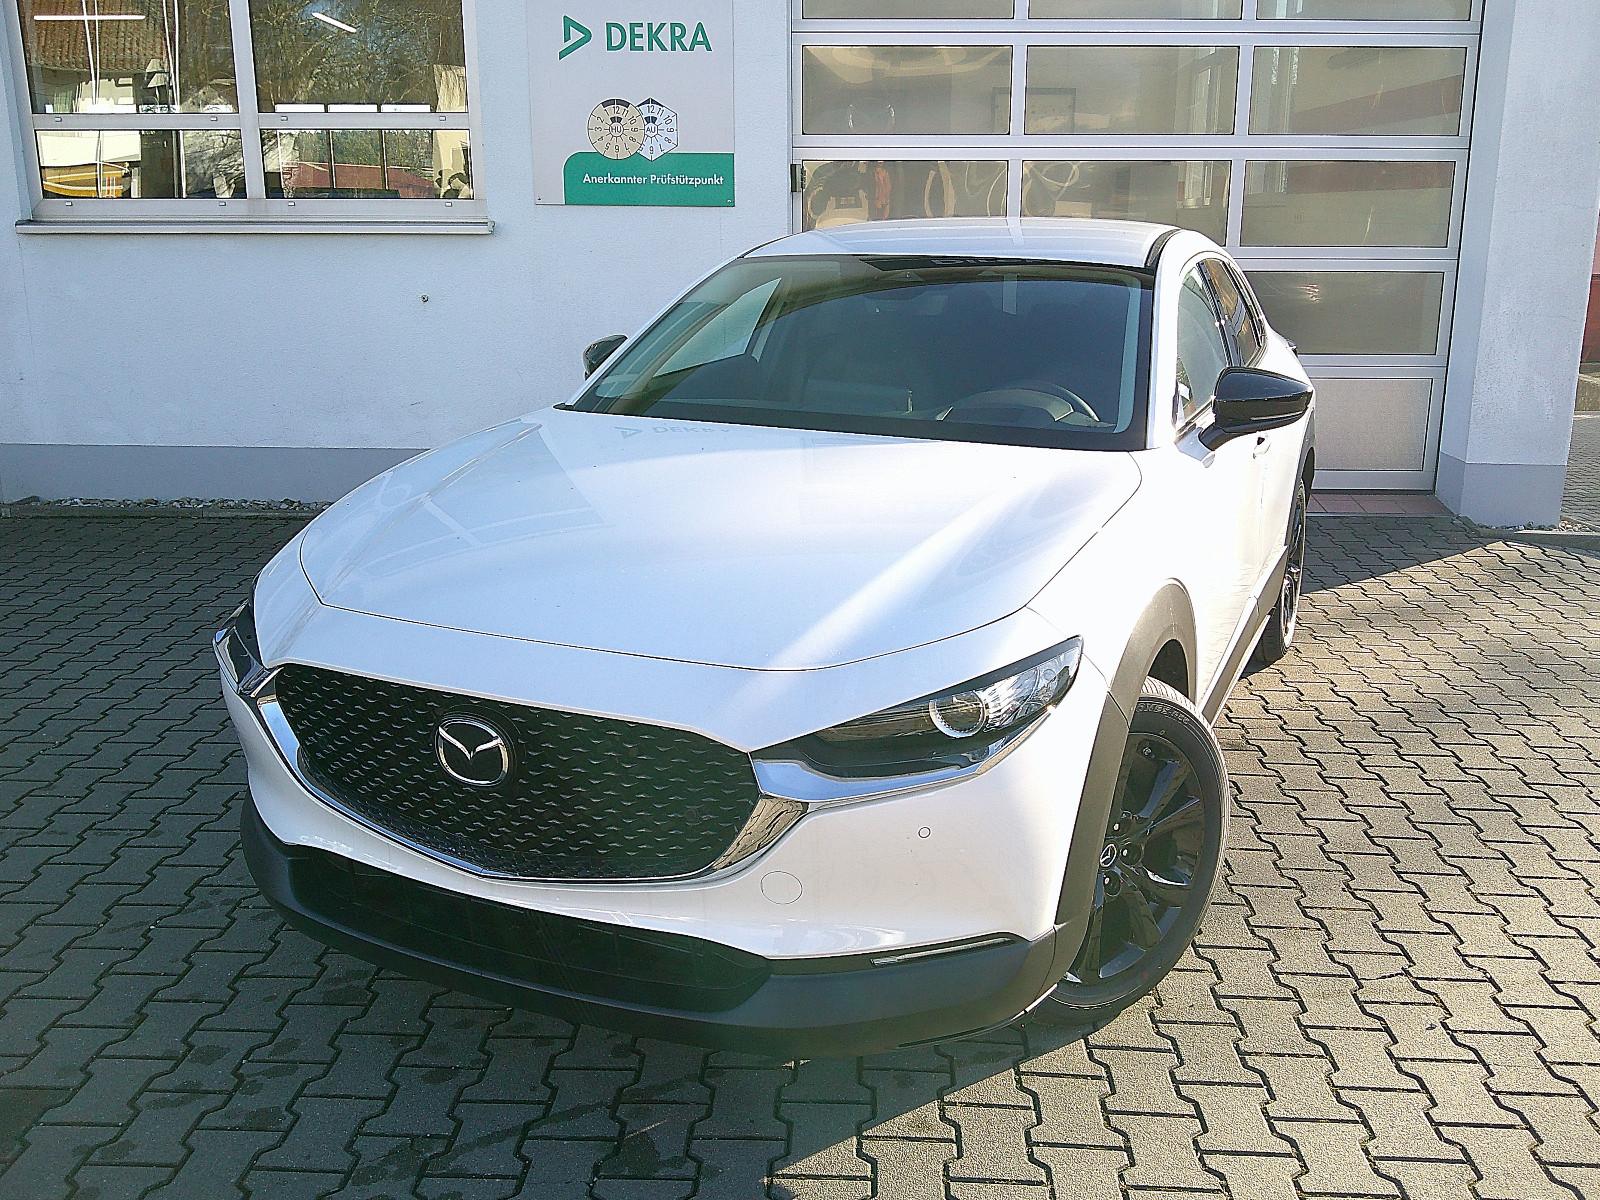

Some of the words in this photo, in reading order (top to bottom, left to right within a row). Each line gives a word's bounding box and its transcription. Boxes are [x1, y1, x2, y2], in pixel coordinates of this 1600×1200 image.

[606, 22, 712, 51] DEKRA
[613, 106, 620, 114] 12
[622, 108, 629, 117] 11
[647, 105, 655, 114] 12
[657, 108, 664, 117] 11
[628, 115, 637, 125] 10
[663, 115, 672, 125] 10
[583, 173, 647, 184] Anerkannter
[650, 174, 724, 187] Prüfstützpunkt
